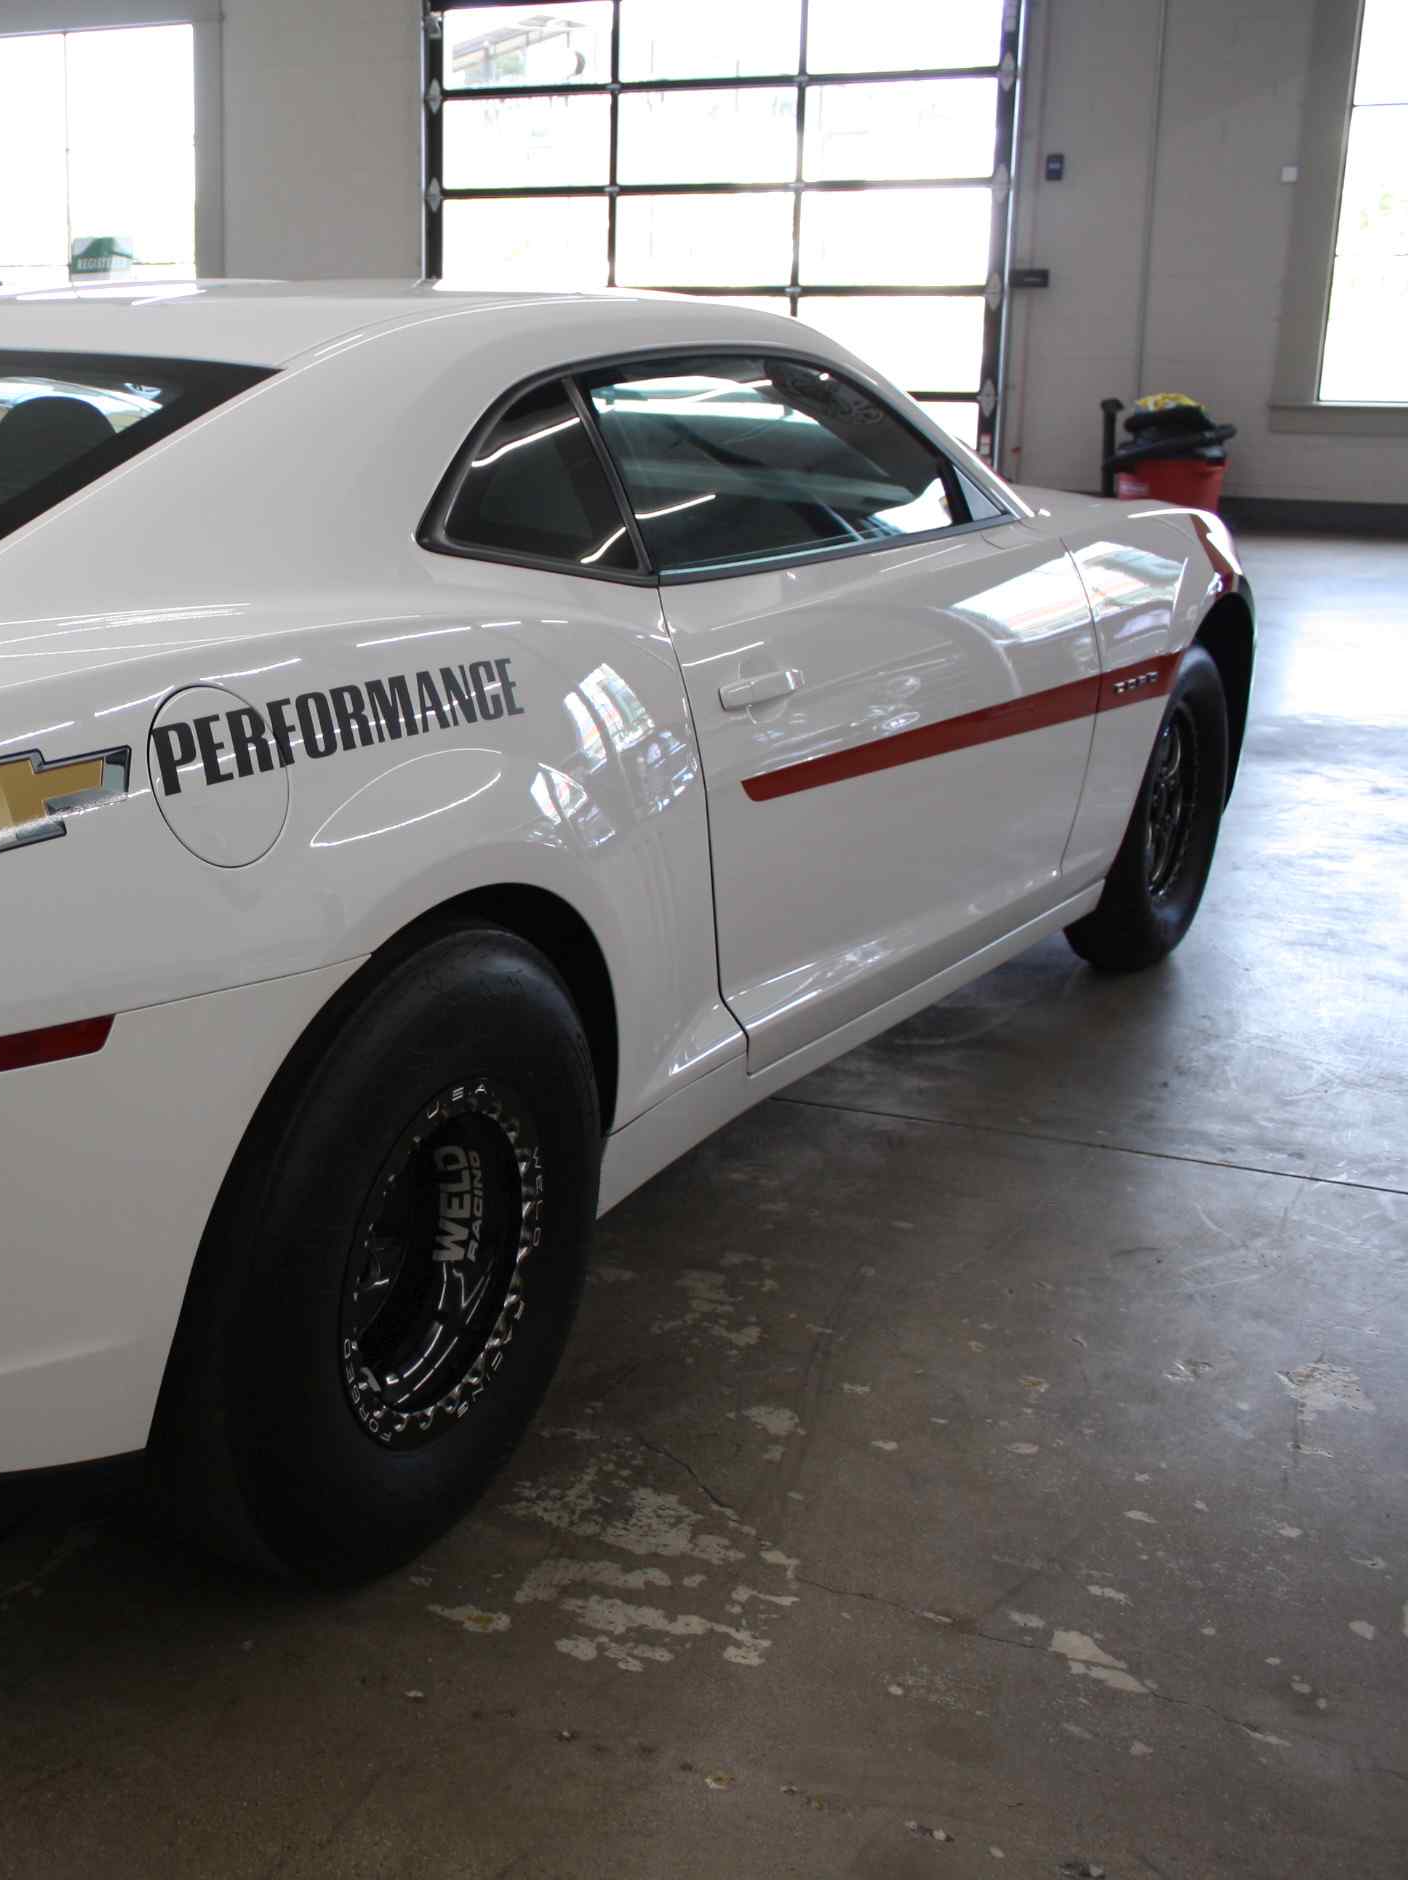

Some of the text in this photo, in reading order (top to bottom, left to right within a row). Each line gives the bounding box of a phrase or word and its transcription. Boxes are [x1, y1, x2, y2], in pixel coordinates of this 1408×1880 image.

[150, 657, 524, 797] PERFORMANCE
[432, 1145, 472, 1262] WELD
[464, 1150, 485, 1263] RACING
